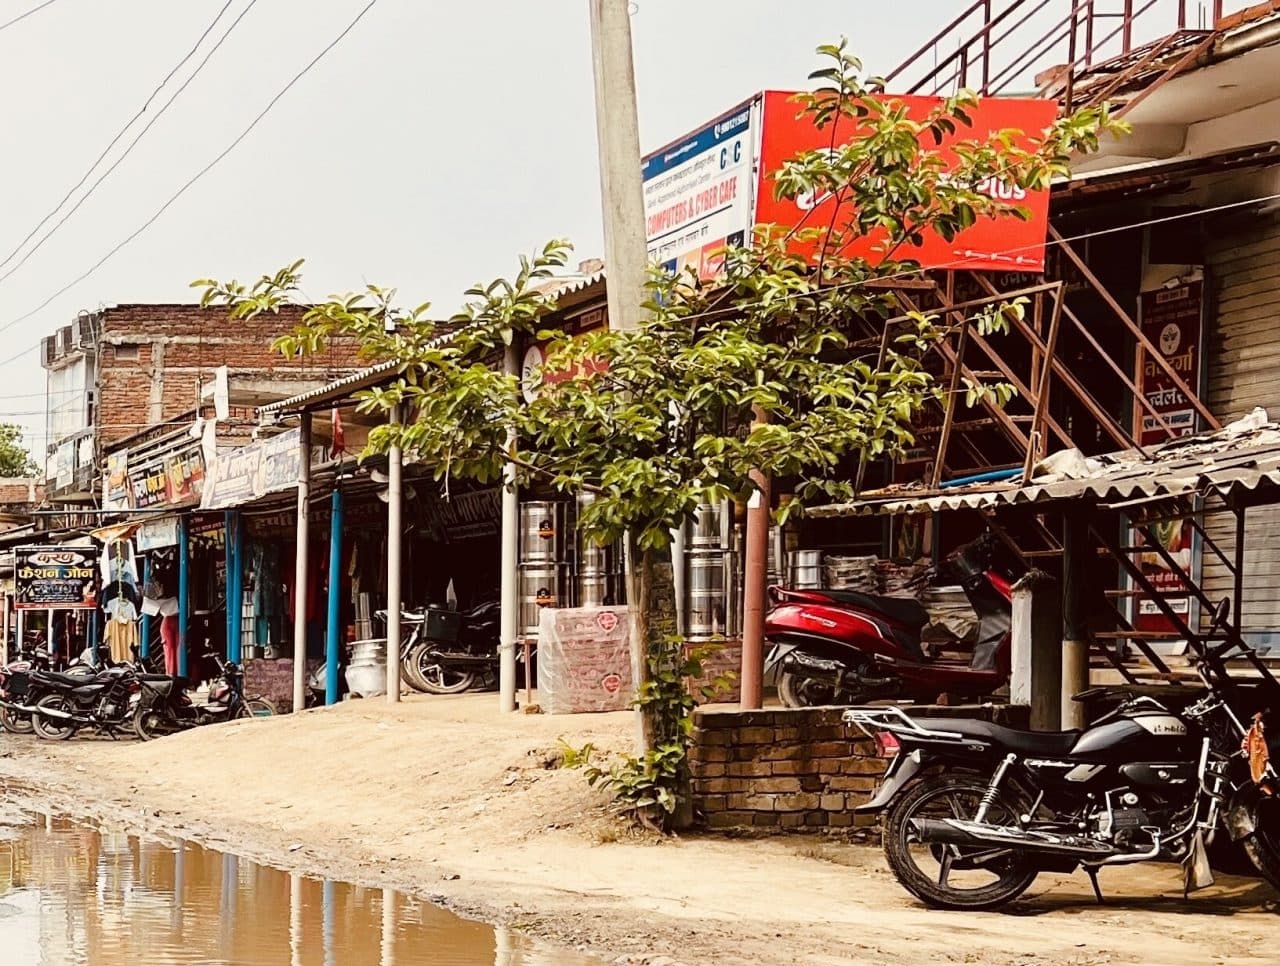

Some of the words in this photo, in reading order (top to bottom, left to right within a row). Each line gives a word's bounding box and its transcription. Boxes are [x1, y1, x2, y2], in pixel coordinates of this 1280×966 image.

[647, 200, 688, 237] COMPUTERS
[688, 196, 695, 219] &
[695, 185, 718, 215] CYBER
[719, 176, 738, 205] CAFE
